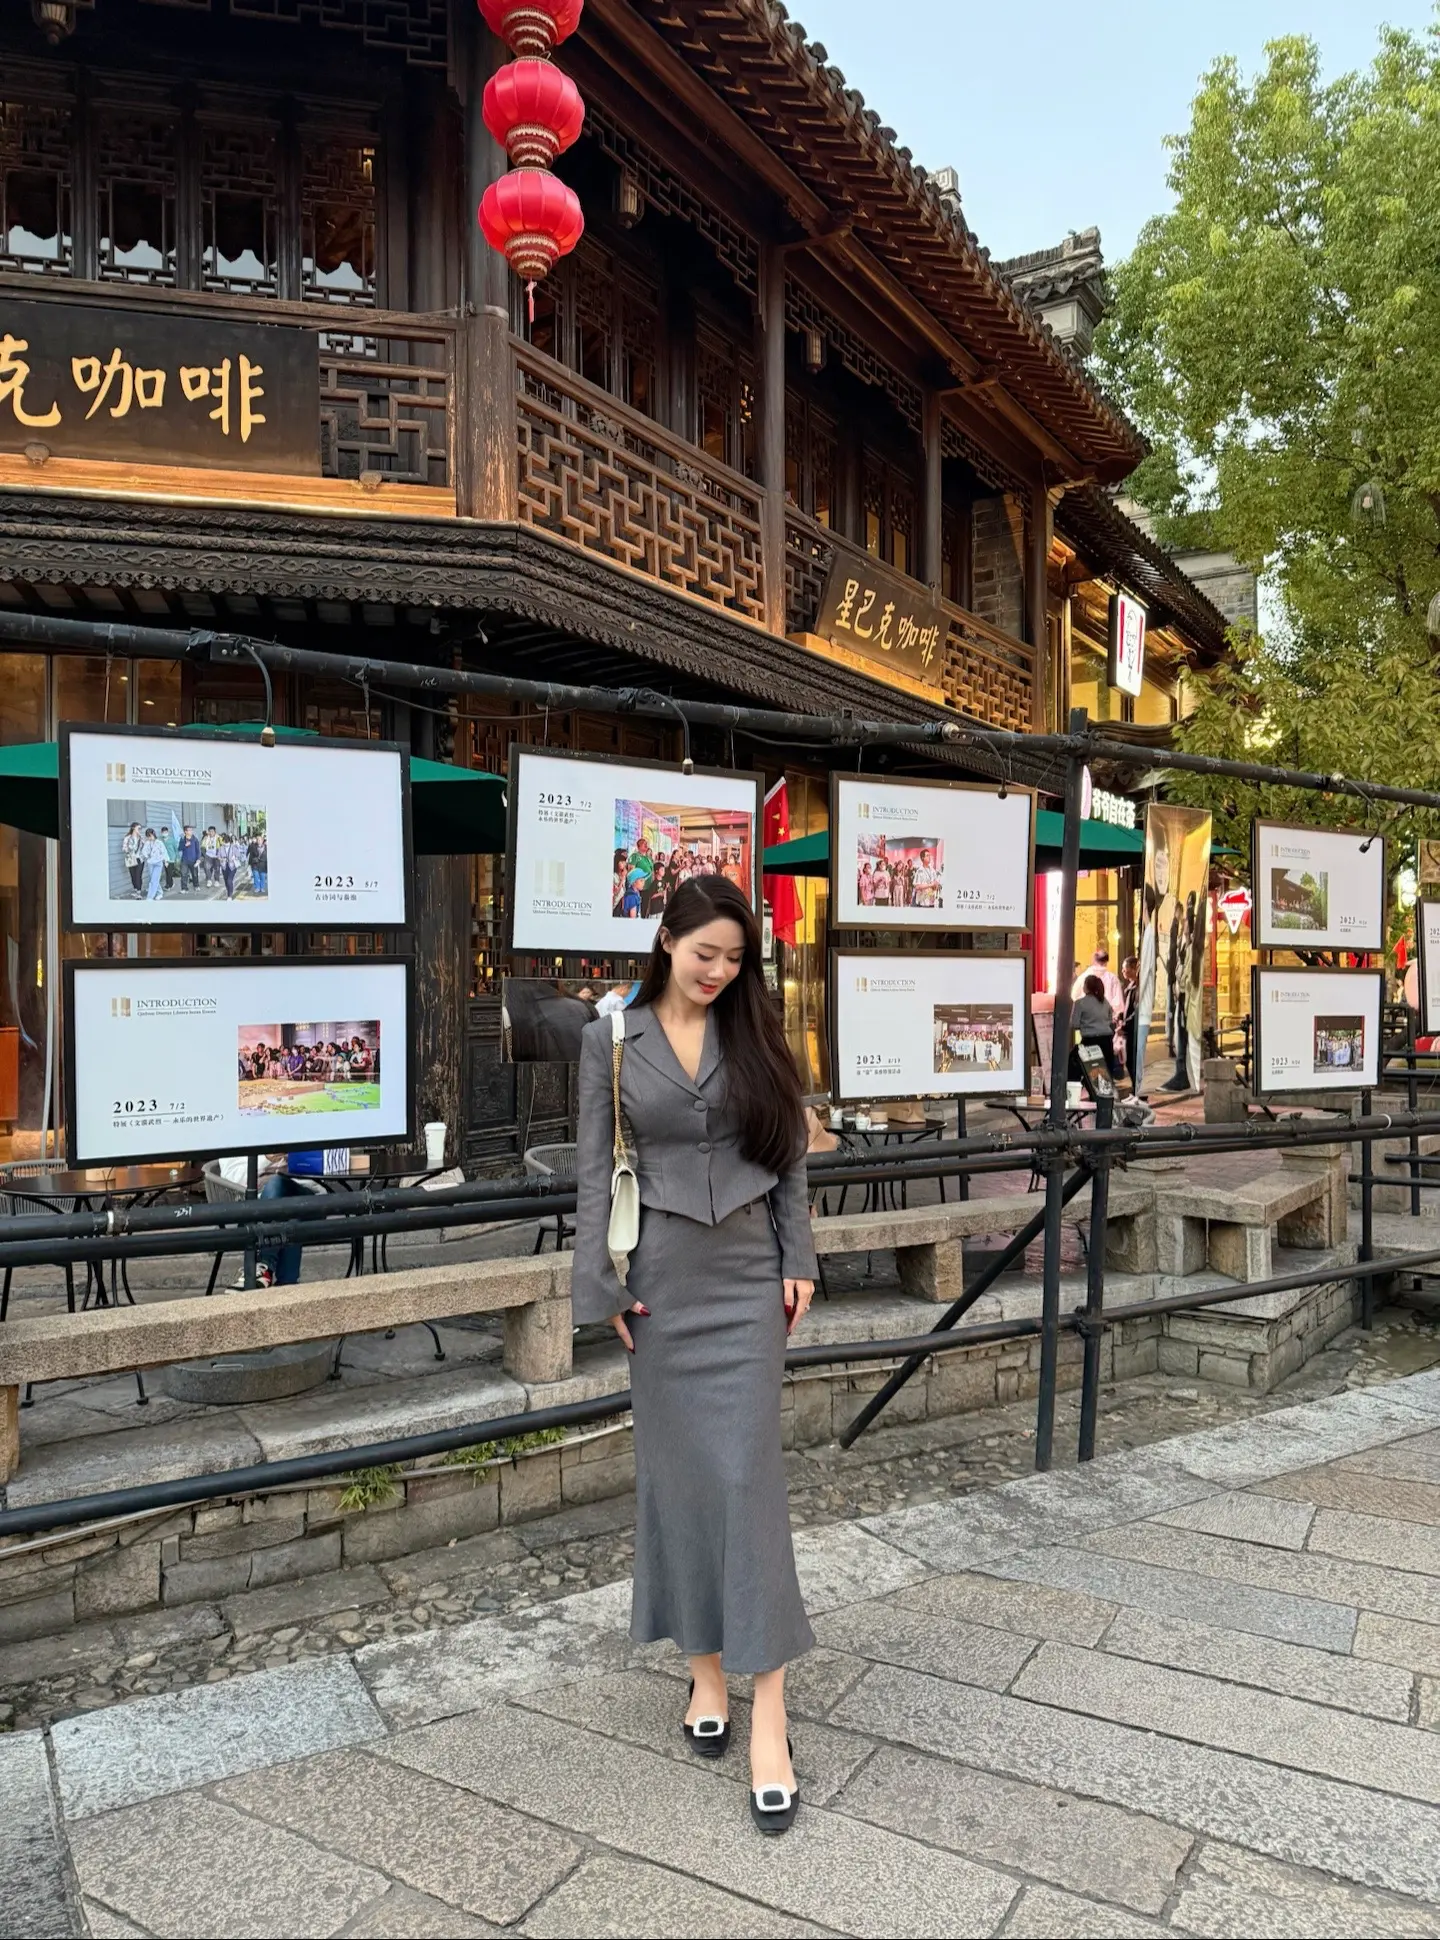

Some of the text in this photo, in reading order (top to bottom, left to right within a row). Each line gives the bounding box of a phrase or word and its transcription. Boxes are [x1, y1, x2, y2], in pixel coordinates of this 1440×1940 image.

[835, 578, 939, 668] 星巴克咖啡
[132, 766, 212, 778] INTRODUCTION
[538, 792, 572, 806] 2023
[872, 806, 919, 815] INTRODUCTION
[314, 875, 378, 888] 2023 5/7
[956, 889, 981, 900] 2023
[532, 899, 592, 909] INTRODUCTION
[136, 997, 217, 1009] INTRODUCTION
[856, 1054, 881, 1065] 2023
[113, 1099, 185, 1114] 2023 7/2
